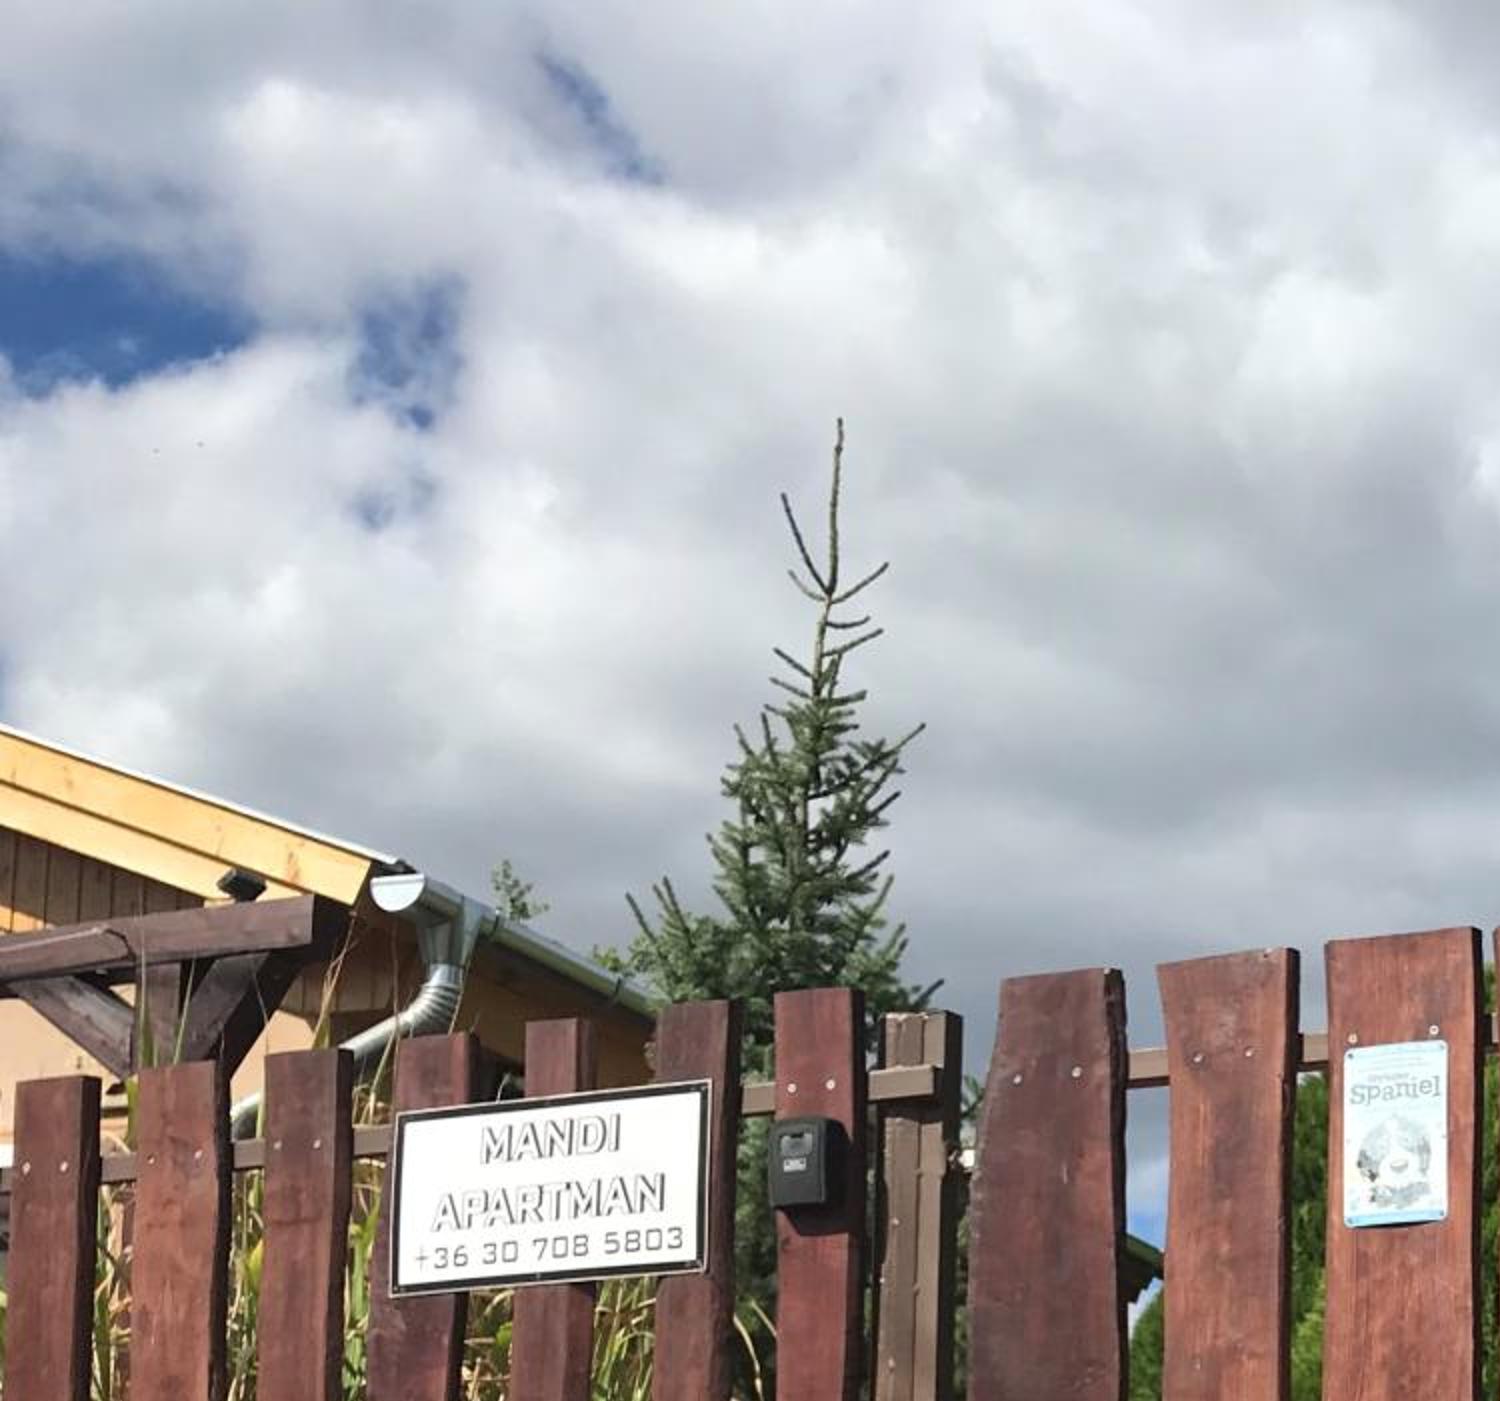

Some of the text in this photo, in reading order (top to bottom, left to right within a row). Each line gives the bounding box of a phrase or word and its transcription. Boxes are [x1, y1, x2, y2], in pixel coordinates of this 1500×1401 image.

[1350, 1076, 1441, 1106] Spaniel
[479, 1112, 622, 1165] MANDI
[430, 1172, 667, 1232] APARTMAN
[415, 1226, 684, 1272] +36 30 708 5803
